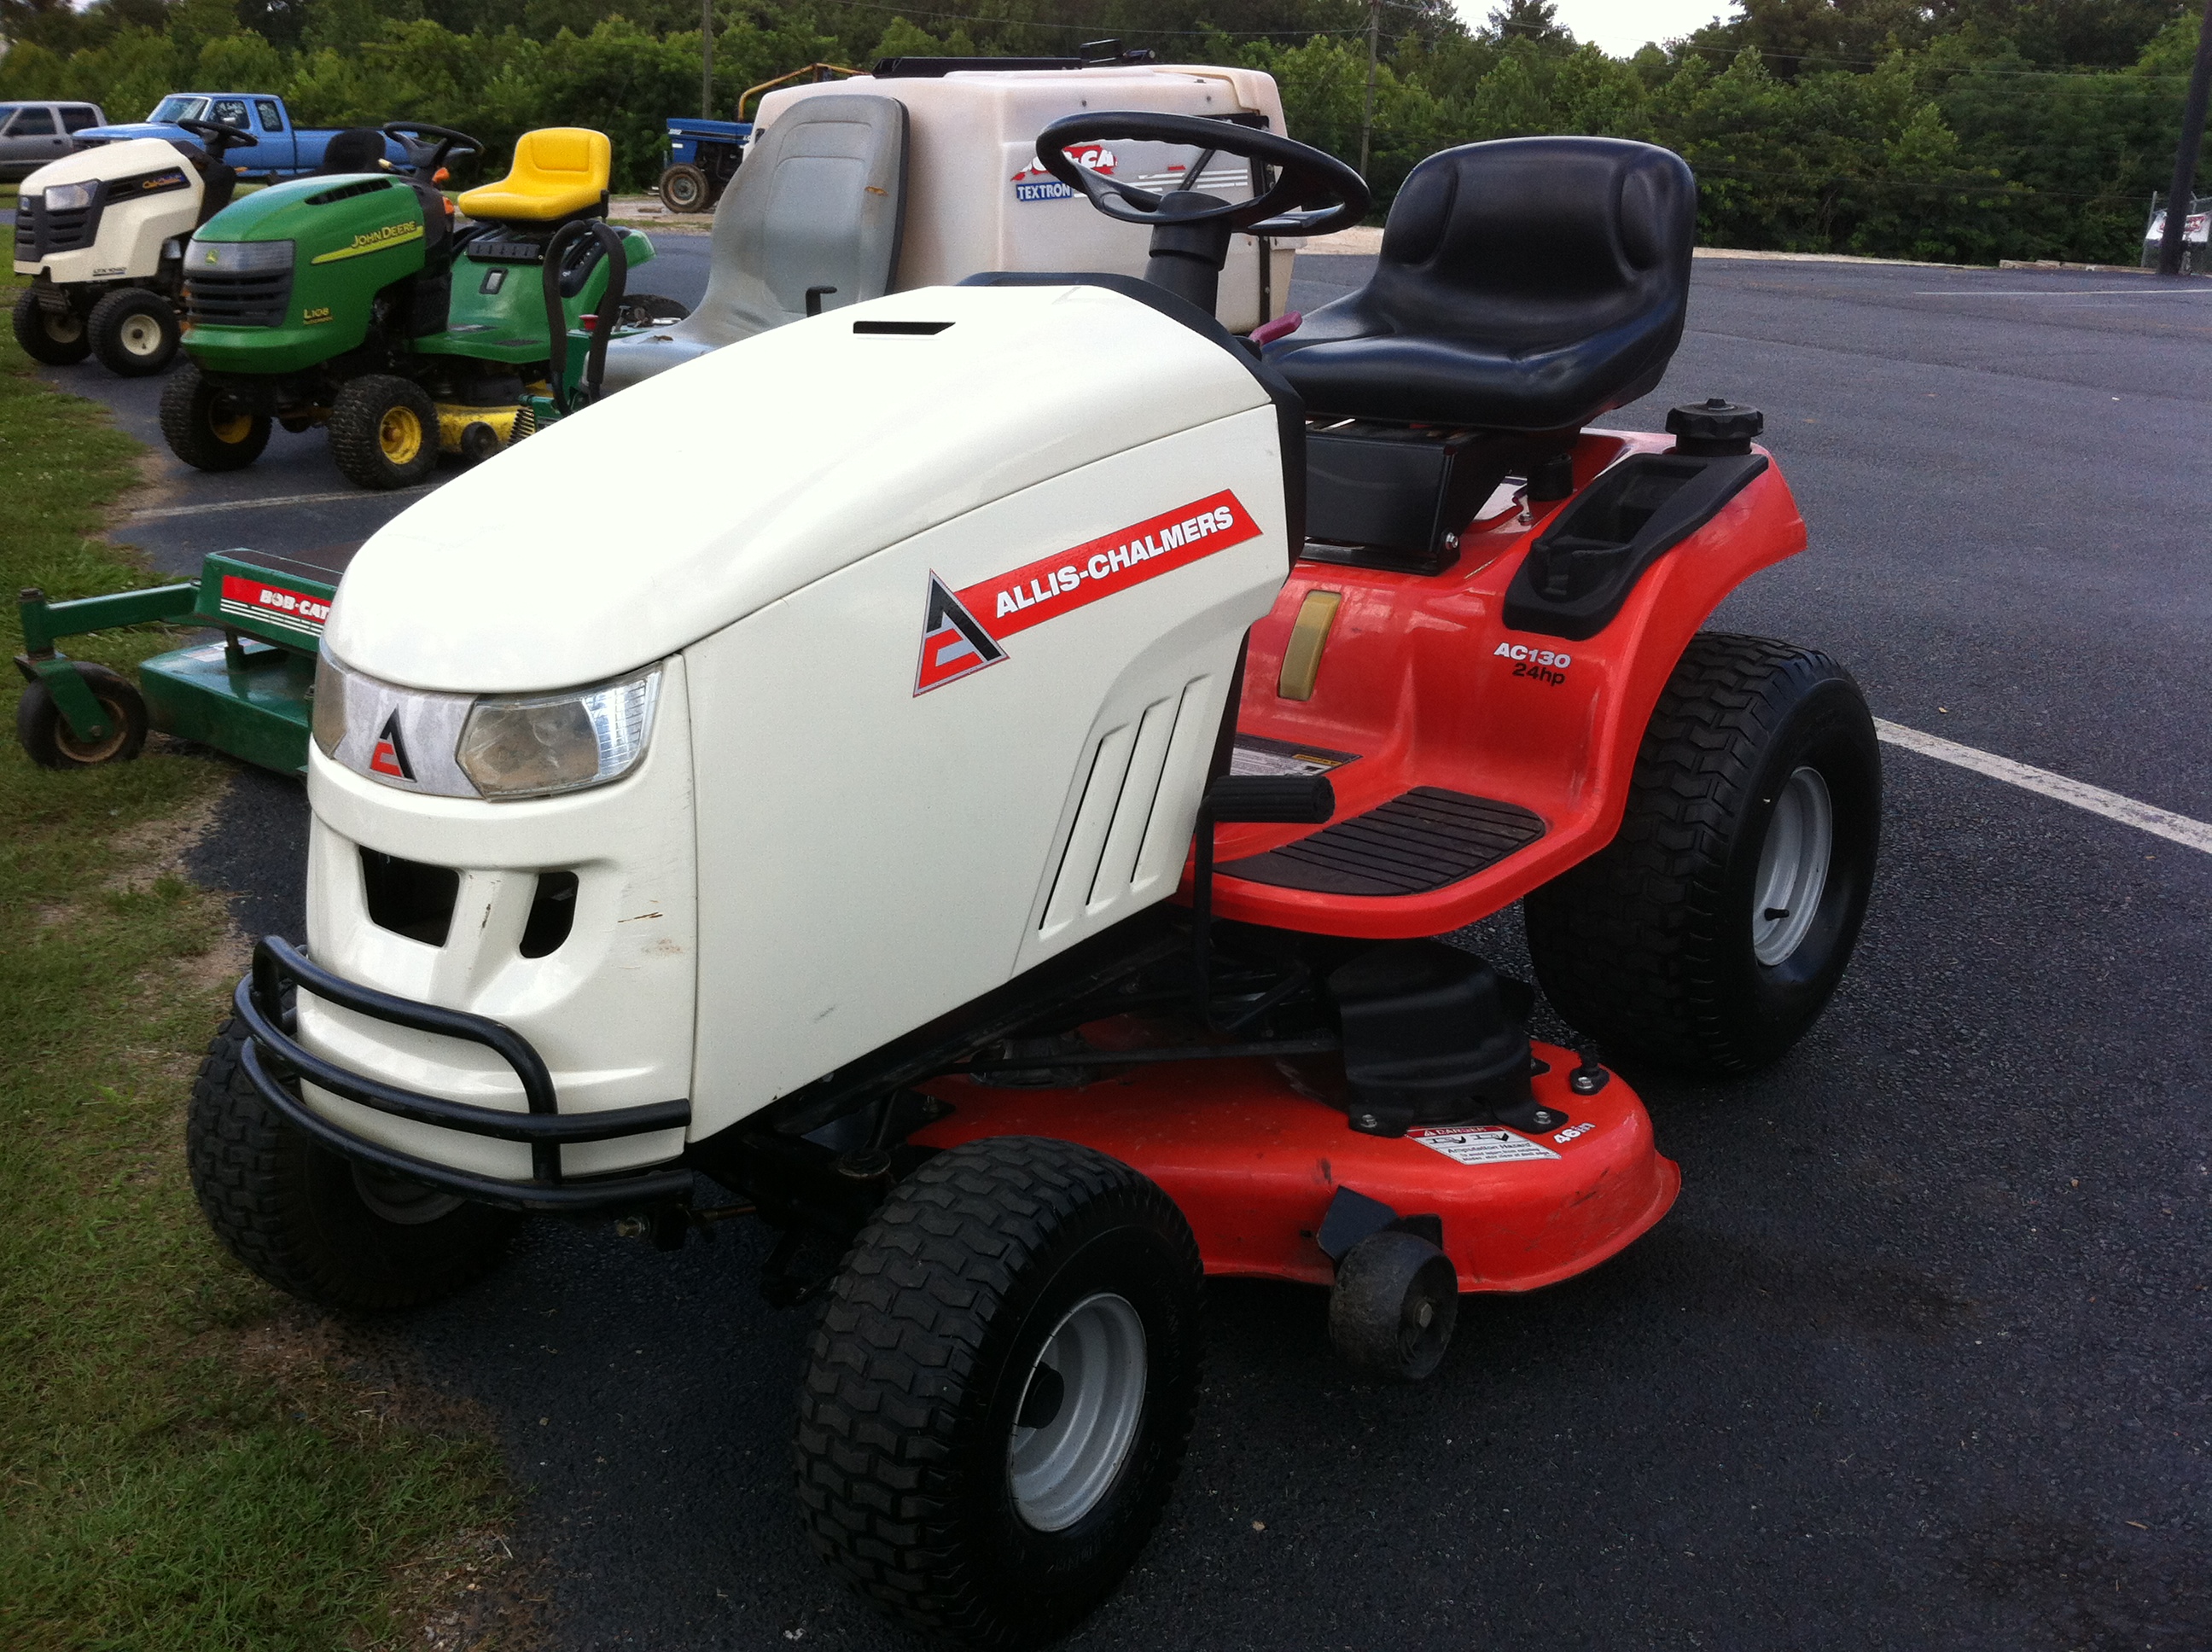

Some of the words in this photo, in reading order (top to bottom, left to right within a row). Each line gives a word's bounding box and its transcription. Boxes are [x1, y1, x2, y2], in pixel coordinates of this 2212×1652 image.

[1017, 183, 1071, 200] TEXTRON
[351, 231, 381, 248] JOHN
[381, 221, 416, 239] DEERE
[996, 505, 1234, 619] ALLIS-CHALMERS
[1493, 642, 1571, 669] AC130
[1512, 662, 1566, 687] 24hp
